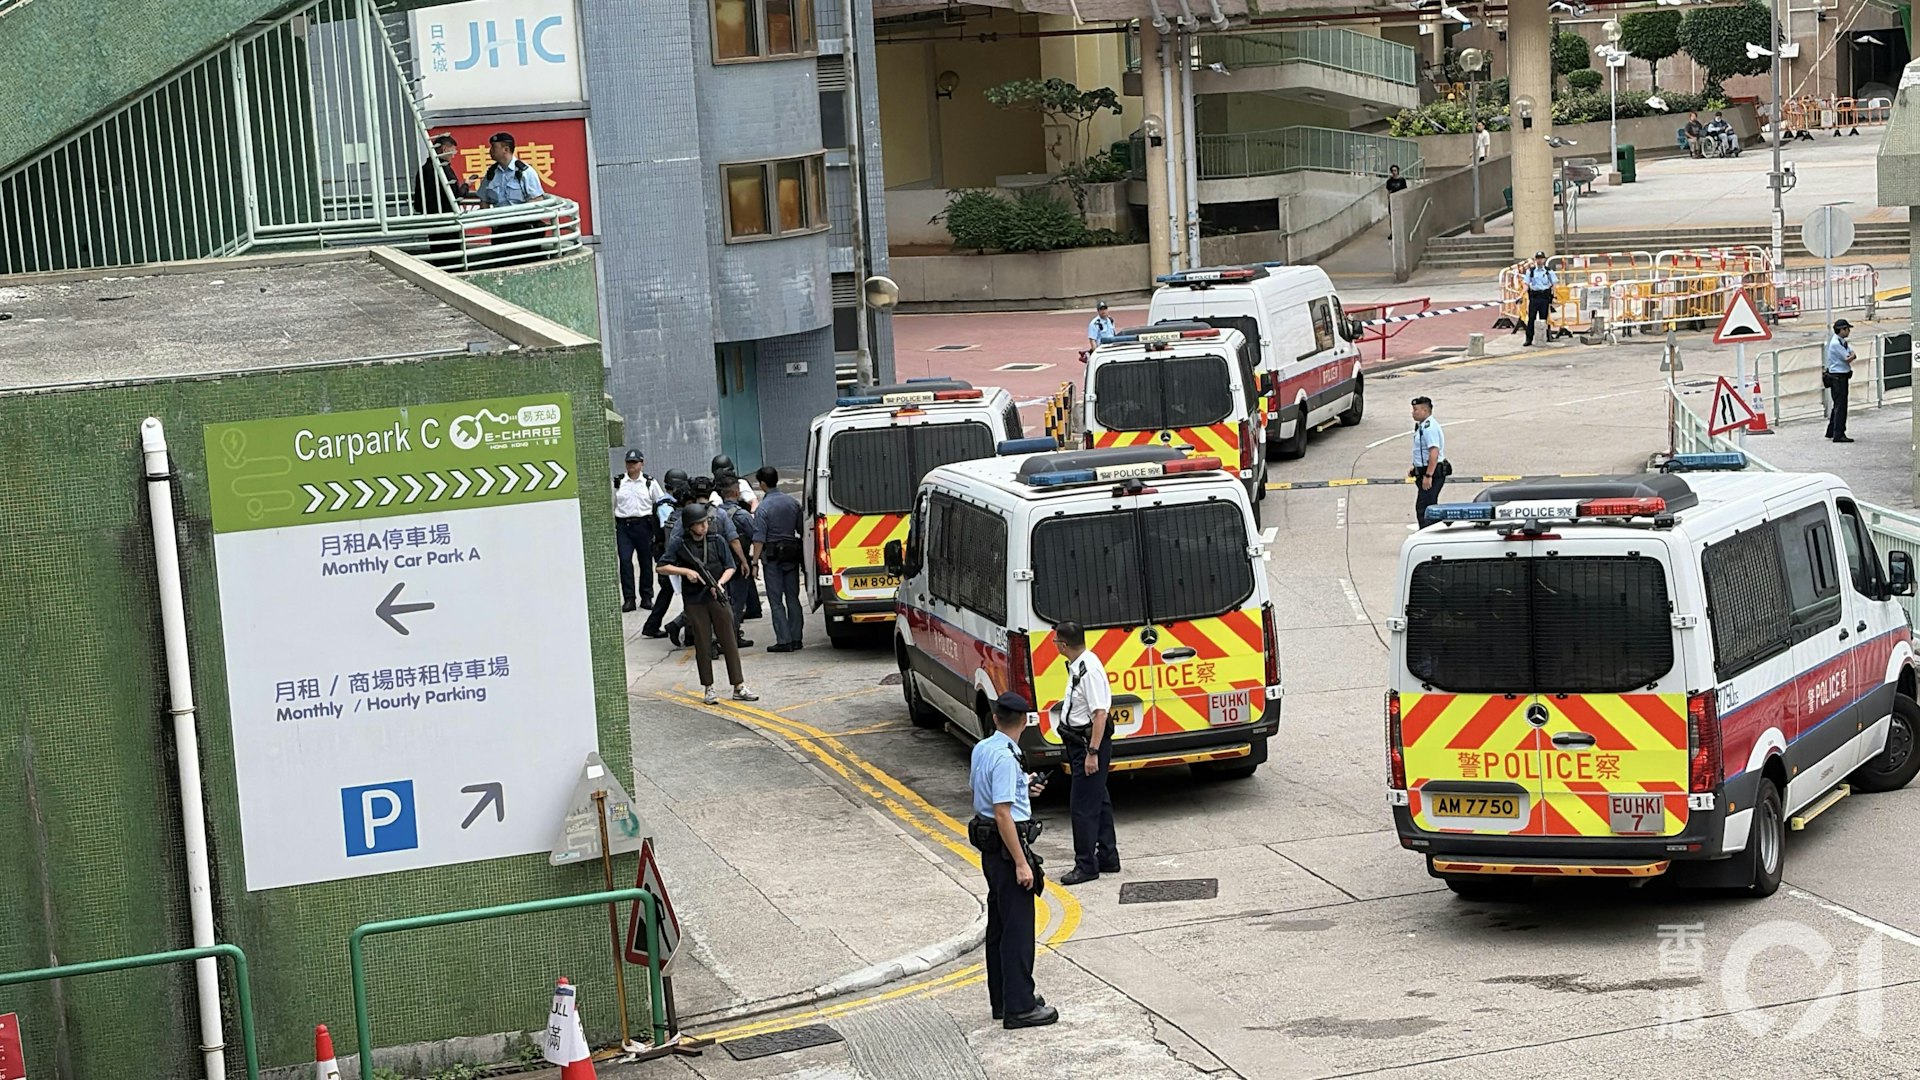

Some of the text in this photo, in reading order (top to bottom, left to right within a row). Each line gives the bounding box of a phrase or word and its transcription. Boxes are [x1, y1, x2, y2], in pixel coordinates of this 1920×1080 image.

[454, 15, 566, 70] JHC
[896, 395, 922, 403] POLICE
[294, 418, 441, 465] Carpark C
[484, 426, 562, 442] E-CHARGE
[1113, 467, 1147, 478] POLICE
[1515, 507, 1555, 518] POLICE
[321, 523, 451, 558] 月租A停車場
[322, 547, 481, 577] Monthly Car Park A
[853, 575, 901, 588] AM 8903
[275, 655, 510, 703] 月租 / 商場時租停車場
[1107, 662, 1217, 692] POLICE察
[1815, 671, 1840, 710] POLICE
[276, 685, 487, 722] Monthly / Hourly Parking
[1112, 708, 1130, 723] 49
[1221, 708, 1238, 722] 10
[361, 788, 402, 849] P
[1438, 798, 1513, 816] AM 7750
[1631, 814, 1644, 832] 7
